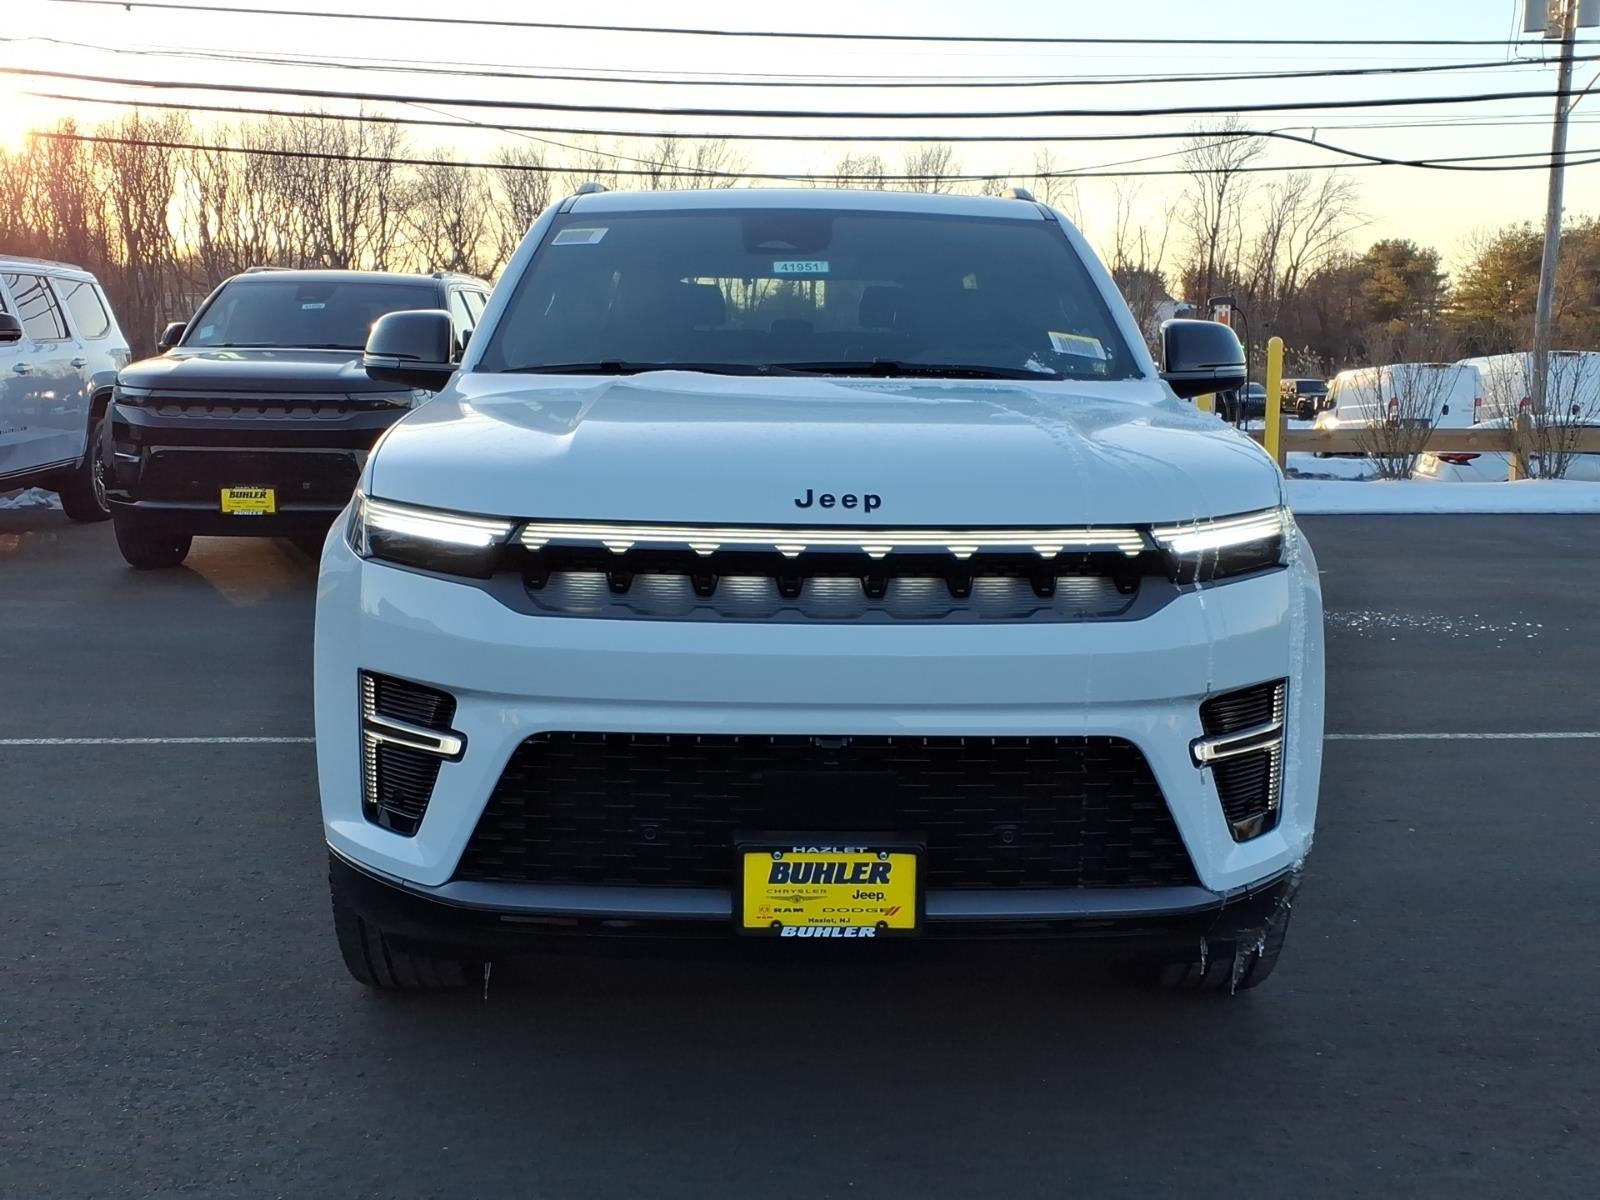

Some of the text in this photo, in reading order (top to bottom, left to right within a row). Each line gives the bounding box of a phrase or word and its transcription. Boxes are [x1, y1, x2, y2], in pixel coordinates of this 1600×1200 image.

[780, 262, 820, 272] 41951
[794, 488, 882, 513] Jeep
[792, 846, 869, 854] HAZLET
[768, 861, 892, 885] BUHLER
[852, 889, 884, 902] Jeep
[780, 926, 876, 938] BUHLER
